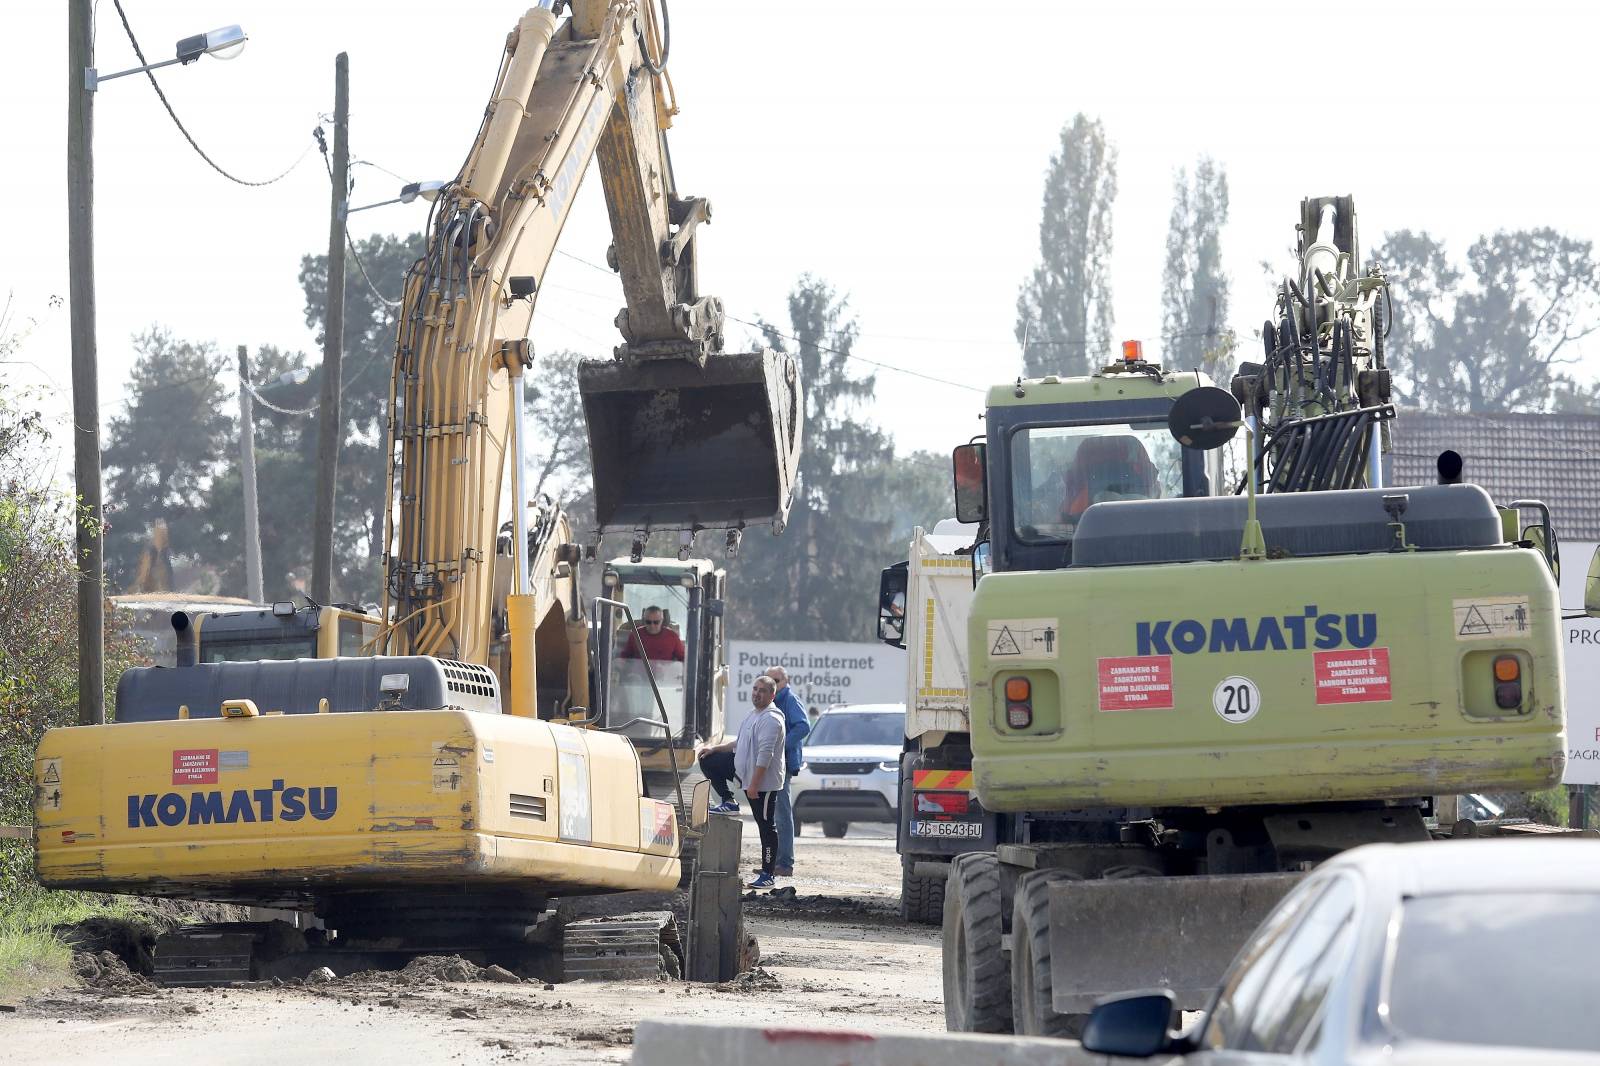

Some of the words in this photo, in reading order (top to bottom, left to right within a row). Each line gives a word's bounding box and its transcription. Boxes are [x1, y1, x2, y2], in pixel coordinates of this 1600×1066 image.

[1136, 605, 1377, 656] KOMATSU
[738, 651, 804, 668] Pokućni
[808, 654, 874, 670] internet
[737, 670, 752, 688] je
[738, 691, 747, 702] u
[1223, 684, 1250, 714] 20
[128, 779, 337, 828] KOMATSU
[918, 822, 932, 835] ZG
